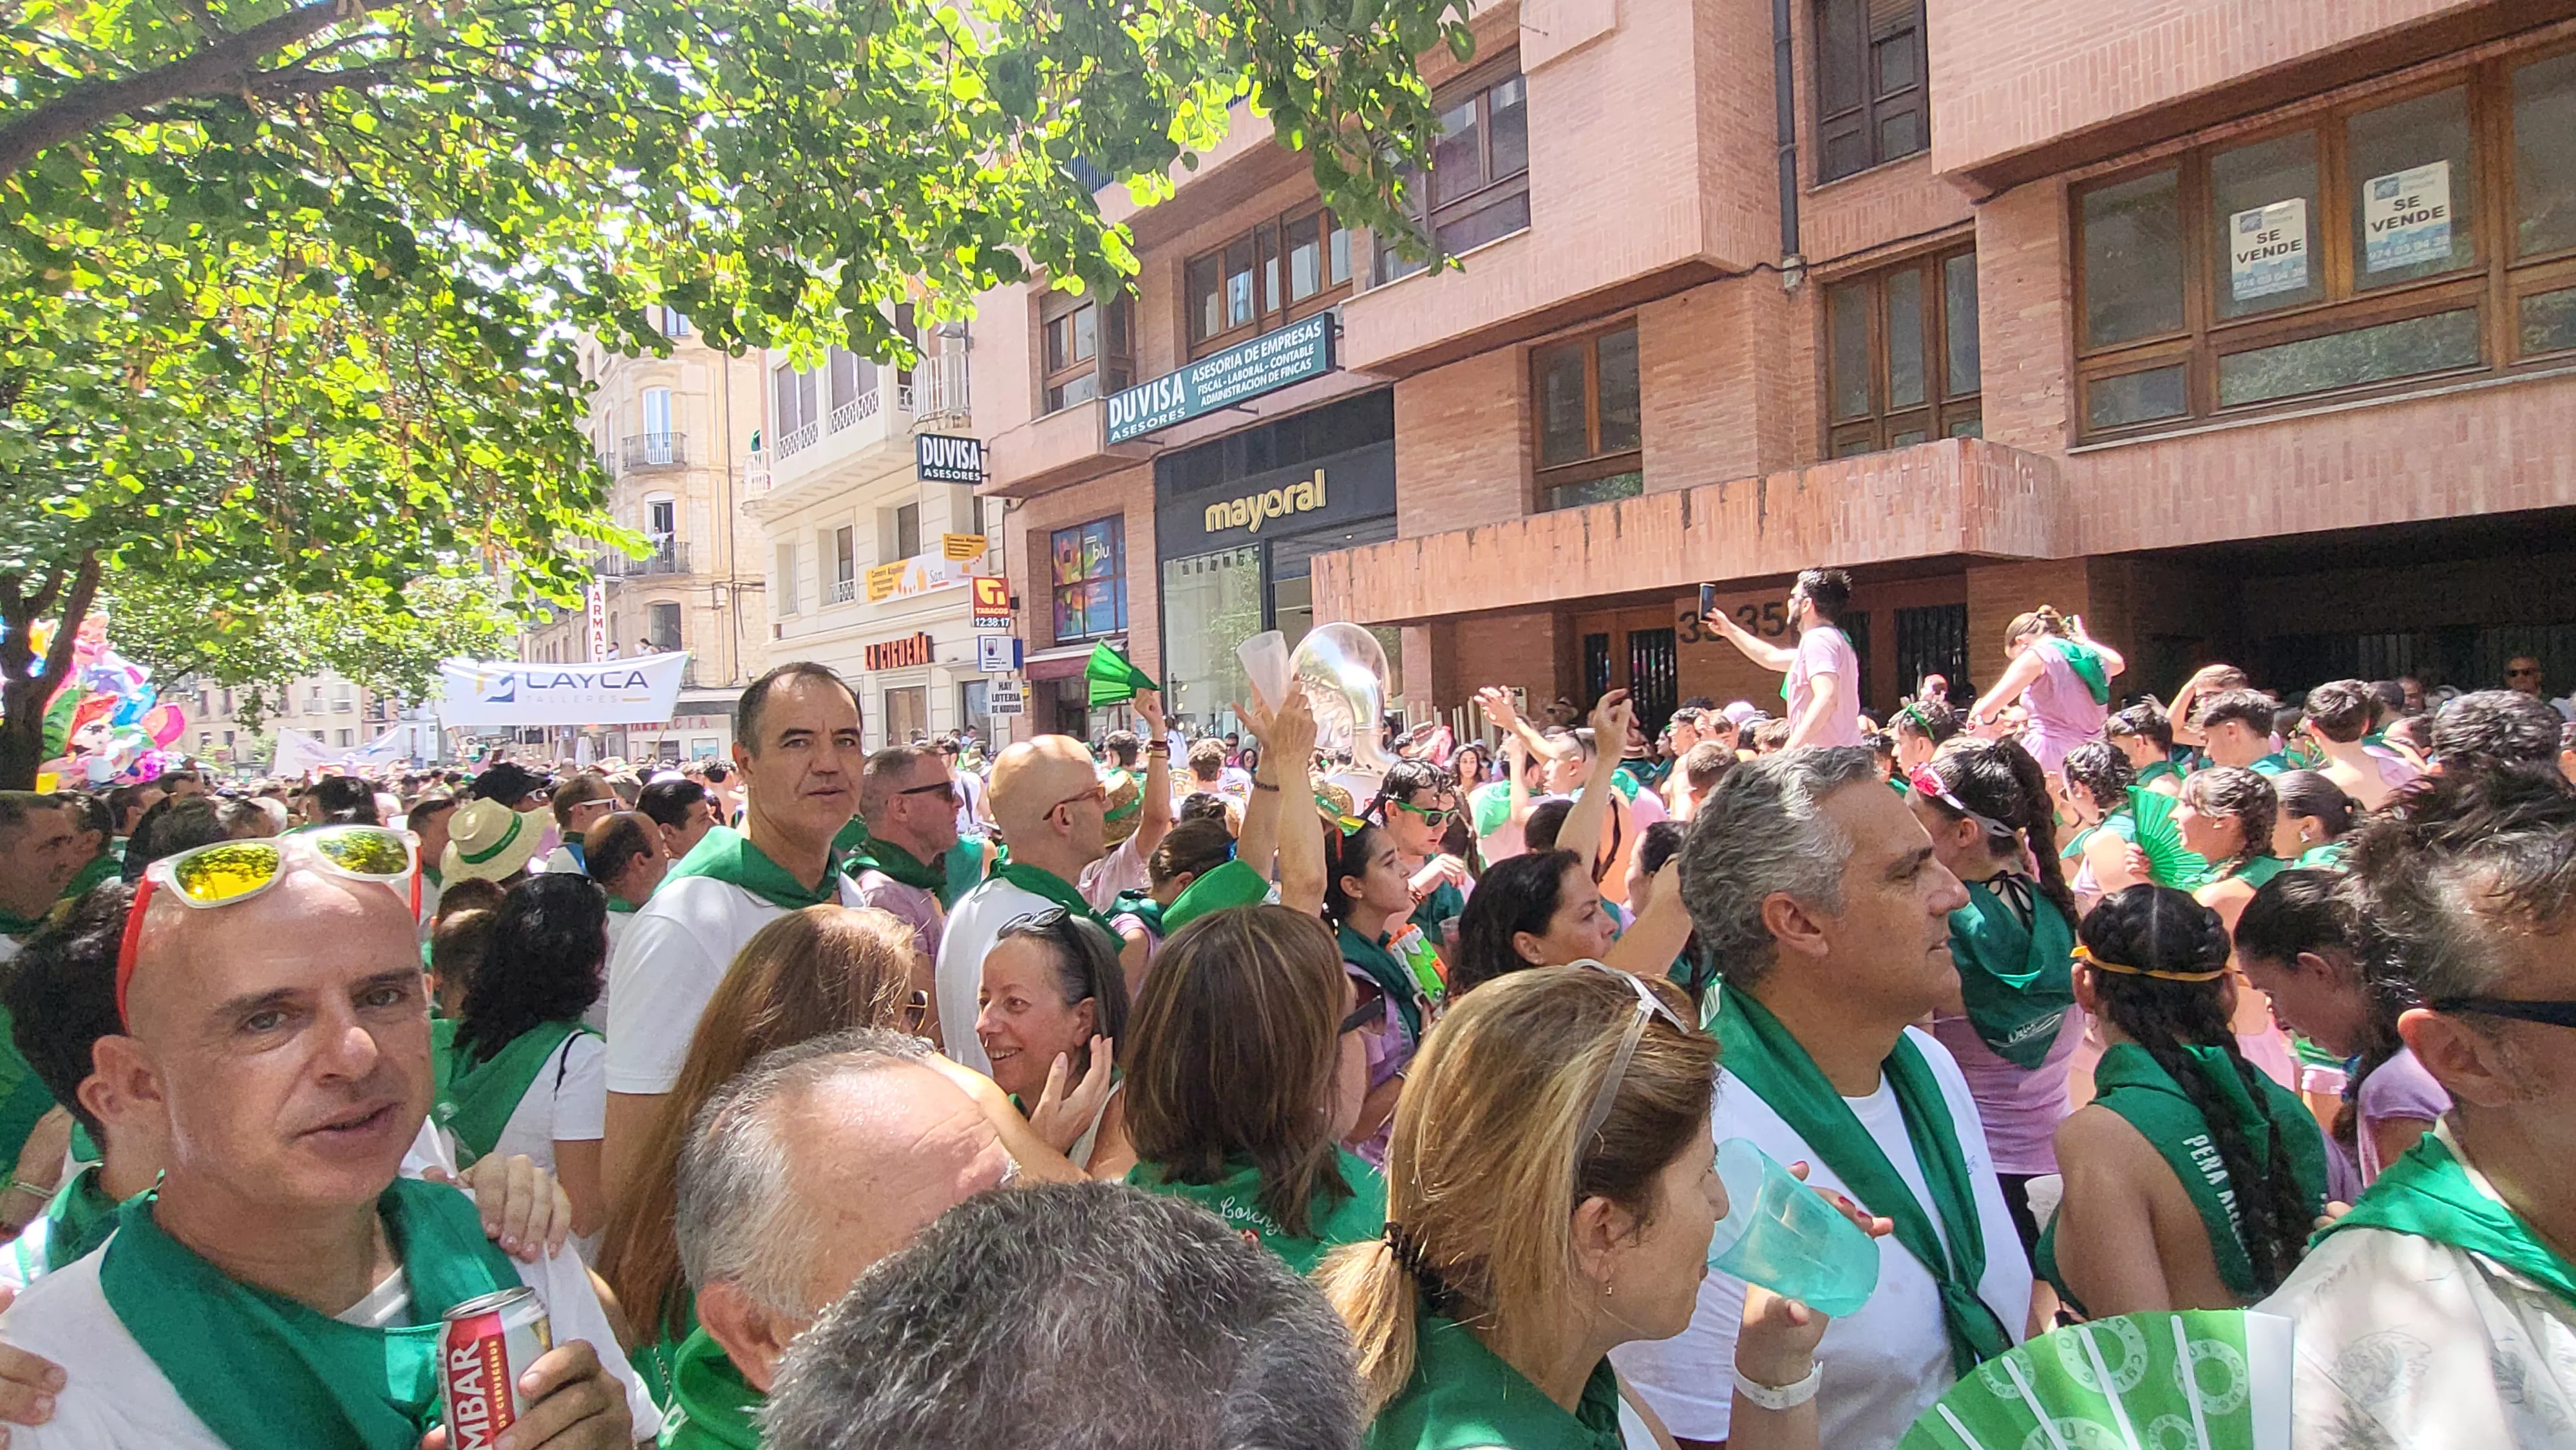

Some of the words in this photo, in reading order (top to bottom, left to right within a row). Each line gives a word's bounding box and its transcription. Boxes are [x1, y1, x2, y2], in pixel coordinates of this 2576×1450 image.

[2393, 195, 2420, 211] SE
[2371, 205, 2445, 232] VENDE
[2255, 229, 2281, 244] SE
[2237, 238, 2302, 264] VENDE
[1191, 352, 1242, 384] ASESORIA
[1244, 345, 1259, 363] DE
[1261, 321, 1321, 357] EMPRESAS
[1270, 343, 1314, 369] CONTABLE
[1200, 373, 1267, 408] ADMINISTRACION
[1268, 368, 1279, 384] DE
[1280, 358, 1312, 379] FINCAS
[1110, 373, 1186, 428] DUVISA
[1112, 408, 1186, 440] ASESORES
[922, 437, 980, 470] DUVISA
[923, 468, 980, 481] ASESORES
[1205, 468, 1326, 533] mayoral
[1093, 543, 1110, 561] blu
[592, 578, 603, 663] FARMAC
[1737, 601, 1785, 637] 35
[864, 645, 876, 670] LA
[526, 670, 649, 689] LAYCA
[998, 681, 1013, 692] HAY
[992, 693, 1021, 702] LOTERIA
[451, 1338, 493, 1450] MBAR
